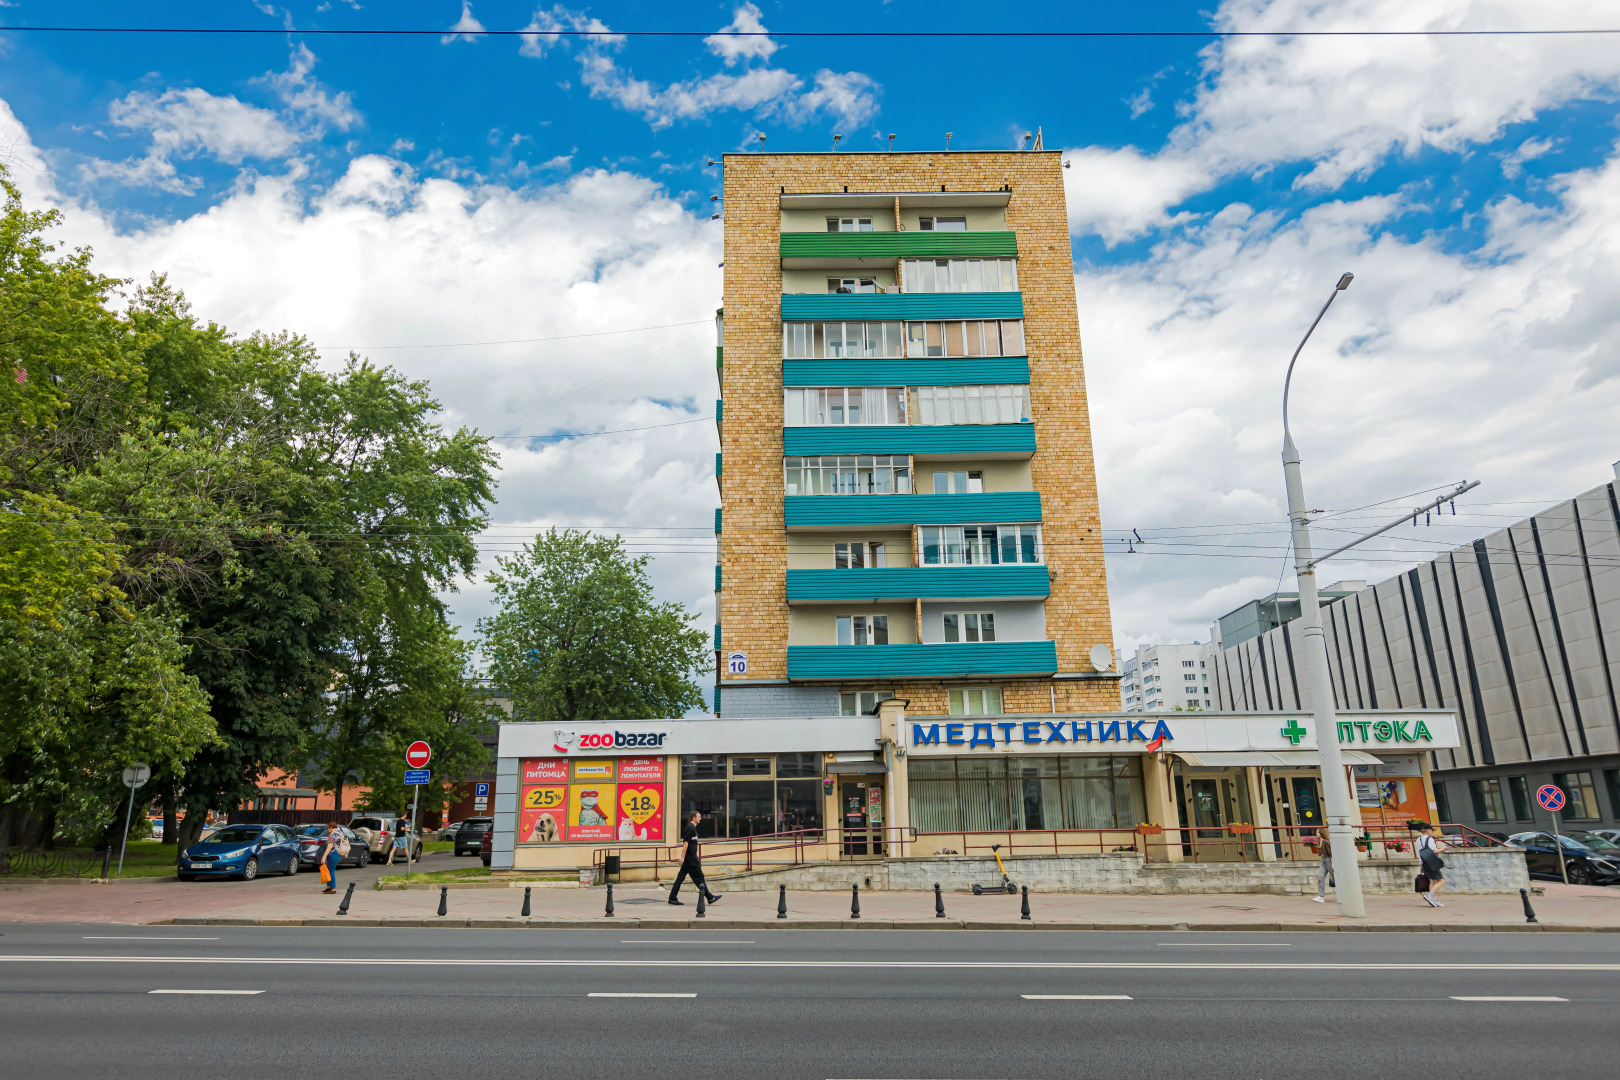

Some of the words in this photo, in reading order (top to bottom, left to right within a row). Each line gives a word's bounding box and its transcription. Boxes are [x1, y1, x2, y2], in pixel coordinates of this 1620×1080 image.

[730, 662, 746, 672] 10
[579, 730, 667, 748] zoobazar
[912, 719, 1174, 749] МЕДТЕХНИКА
[1336, 720, 1434, 743] ПТЭКА
[537, 762, 556, 770] ДНИ
[528, 790, 562, 805] -25%
[625, 796, 656, 811] -18%
